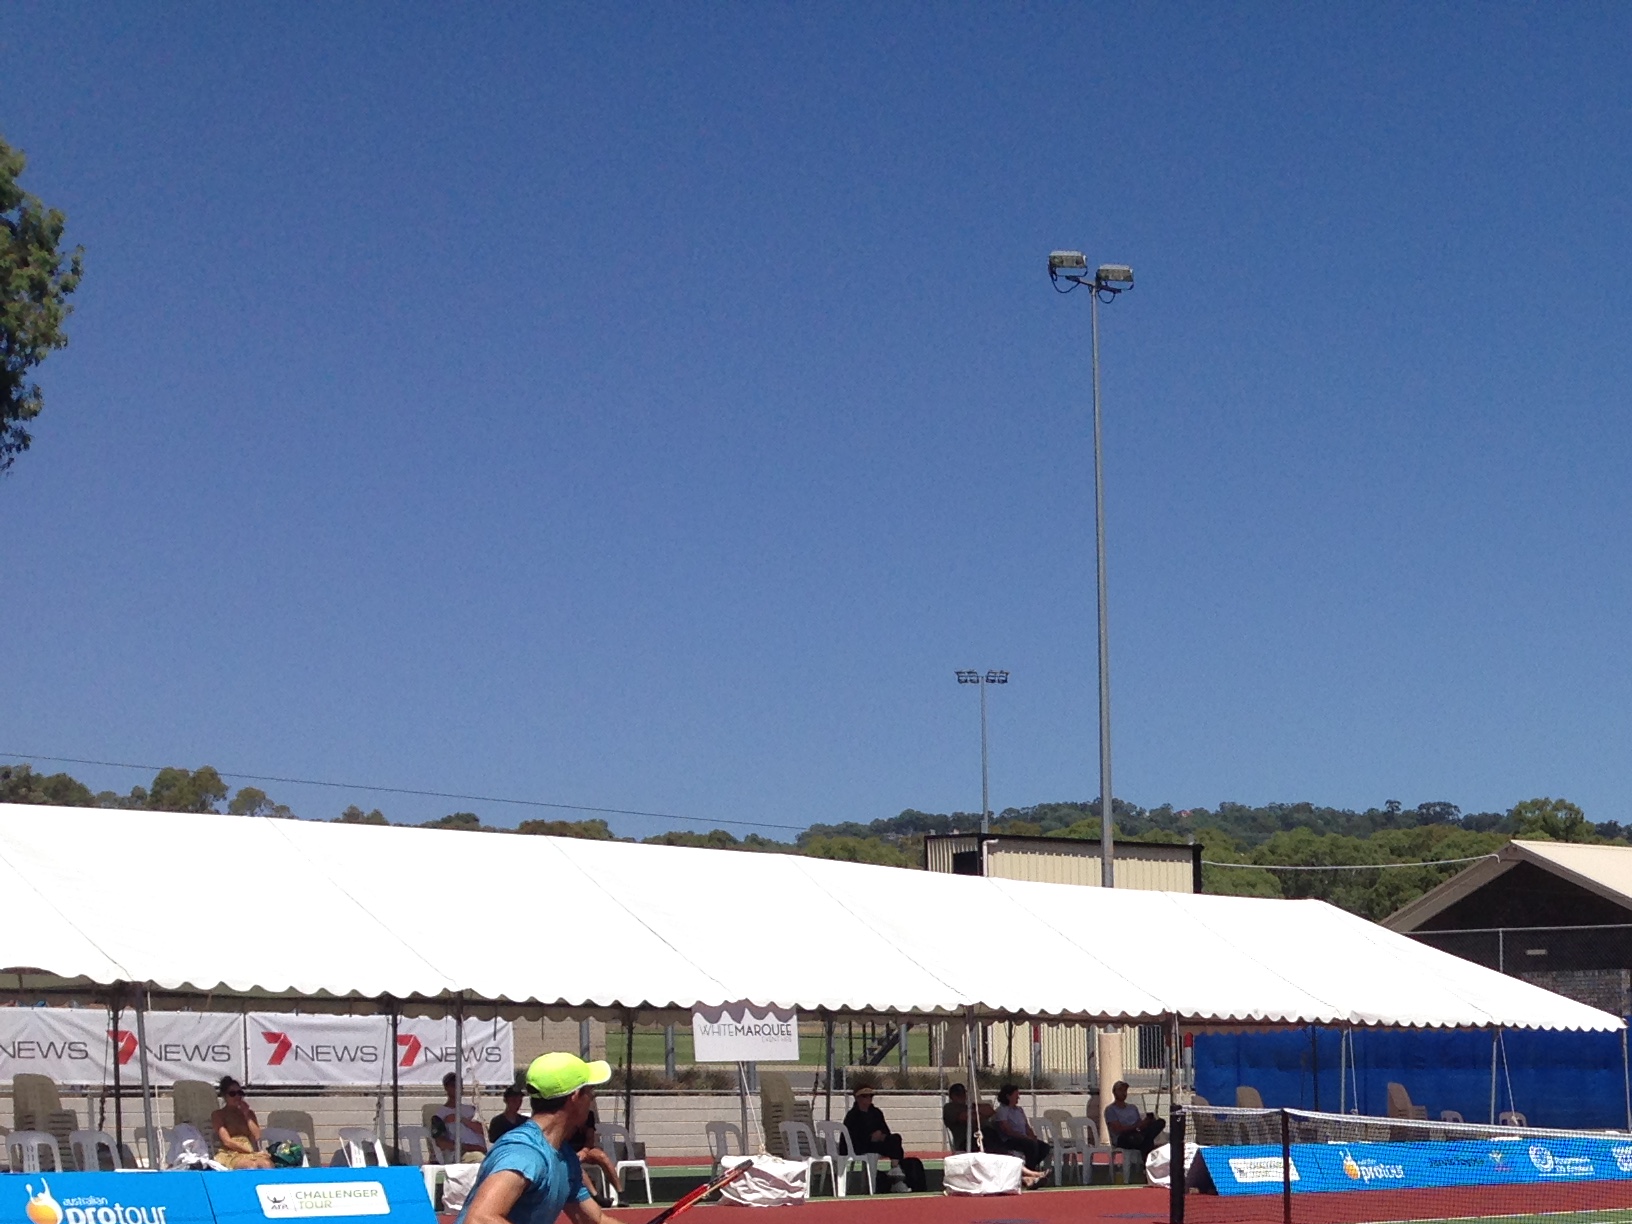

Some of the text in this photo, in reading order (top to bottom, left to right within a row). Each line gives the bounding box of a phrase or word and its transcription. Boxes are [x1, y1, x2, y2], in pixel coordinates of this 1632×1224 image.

[295, 1044, 378, 1062] NEWS
[425, 1046, 502, 1063] NEWS
[295, 1189, 379, 1200] CHALLENGER
[63, 1195, 109, 1206] australian
[299, 1200, 333, 1210] TOUR
